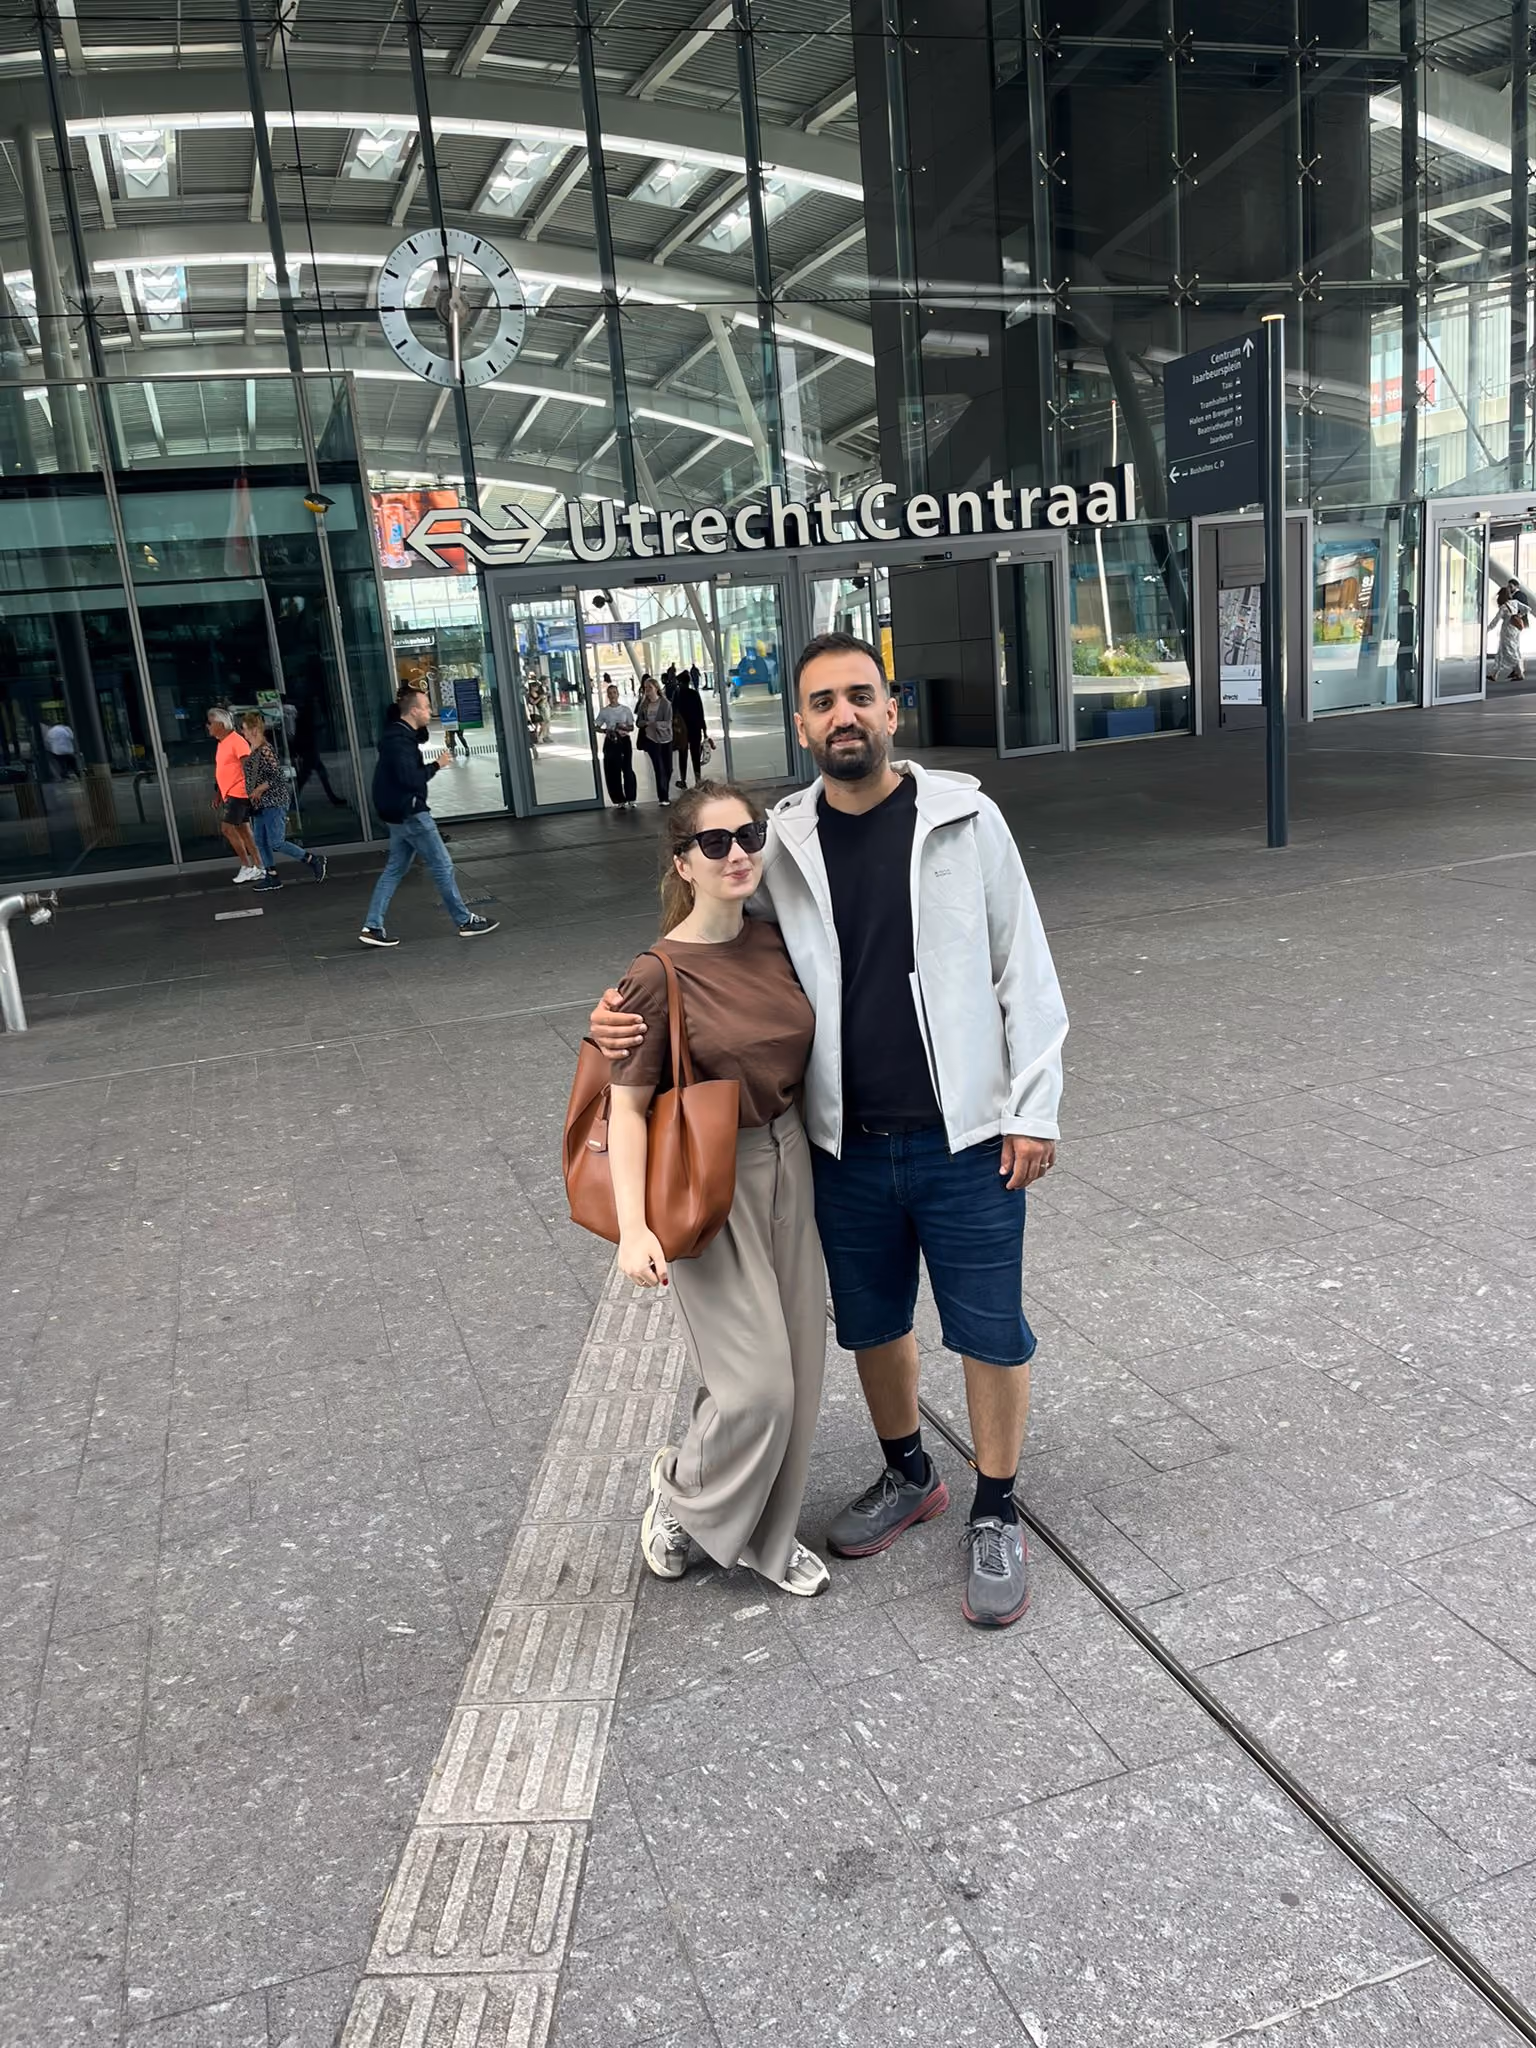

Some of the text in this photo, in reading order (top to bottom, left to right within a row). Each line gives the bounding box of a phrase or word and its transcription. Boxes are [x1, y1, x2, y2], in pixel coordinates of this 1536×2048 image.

[1210, 347, 1241, 365] Centrum
[1191, 360, 1242, 385] Jaarbeursplein
[567, 462, 1137, 562] Utrecht Centraal
